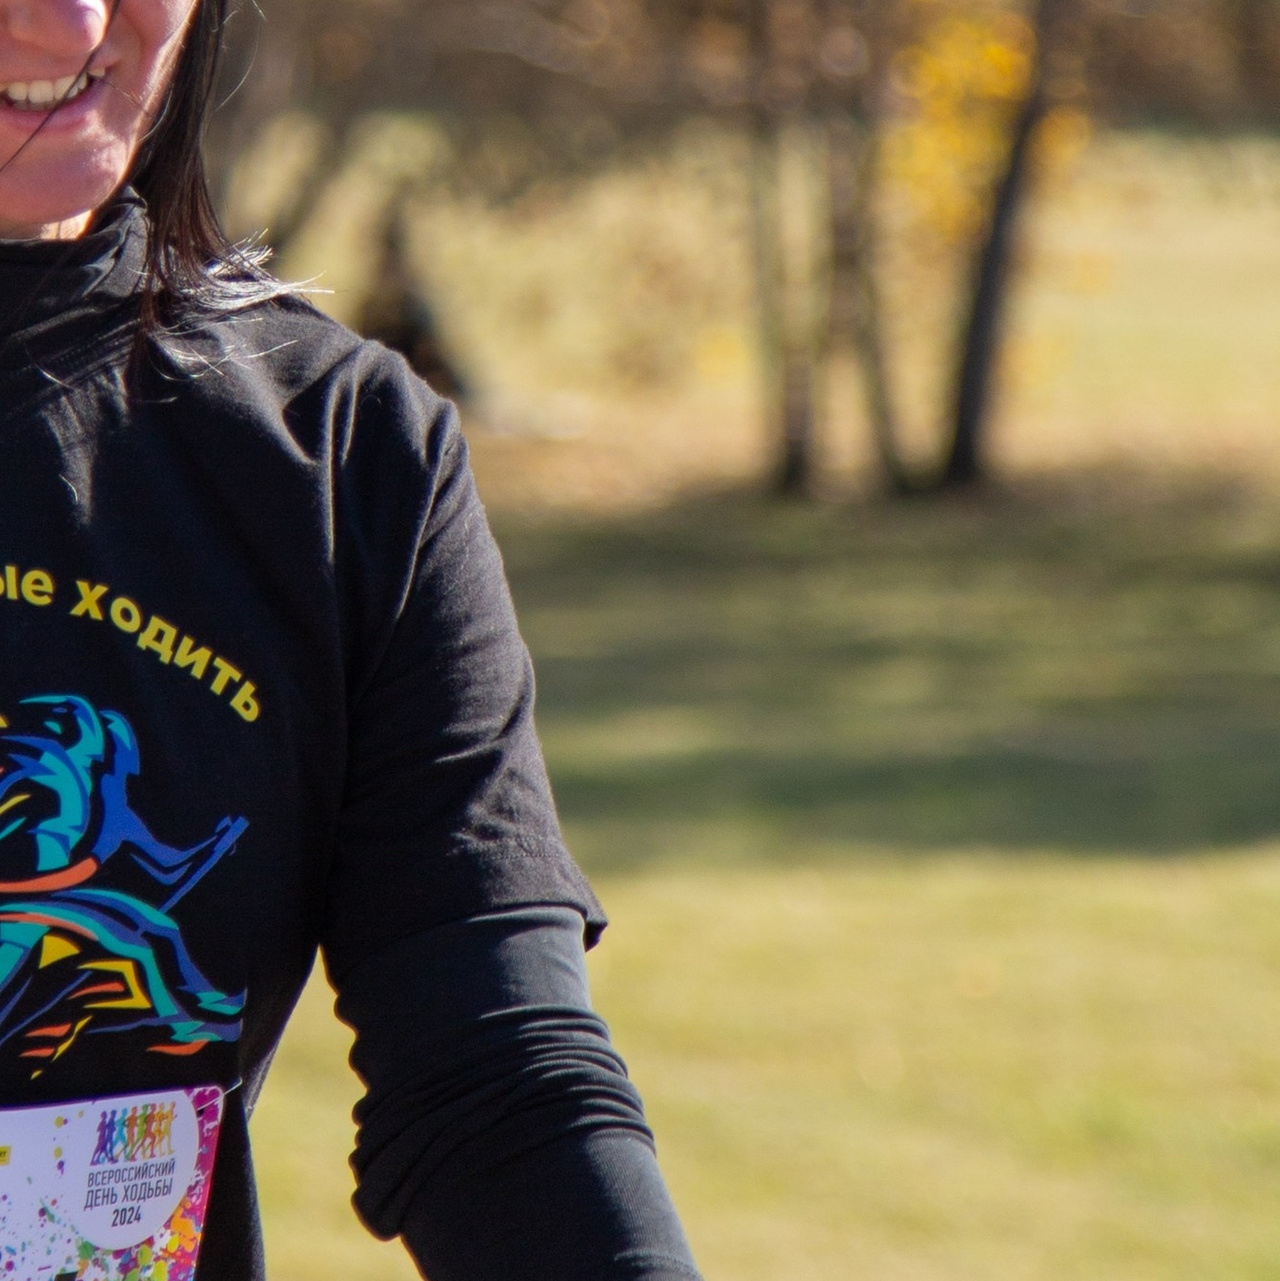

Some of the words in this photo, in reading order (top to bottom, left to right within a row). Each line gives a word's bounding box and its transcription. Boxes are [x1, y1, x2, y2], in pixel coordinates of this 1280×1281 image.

[71, 579, 262, 723] ходить
[87, 1158, 176, 1188] ВСЕРОССИЙСКИЙ
[83, 1186, 119, 1211] ДЕНЬ
[121, 1178, 174, 1204] ХОДЬБЫ
[111, 1205, 142, 1228] 2024
